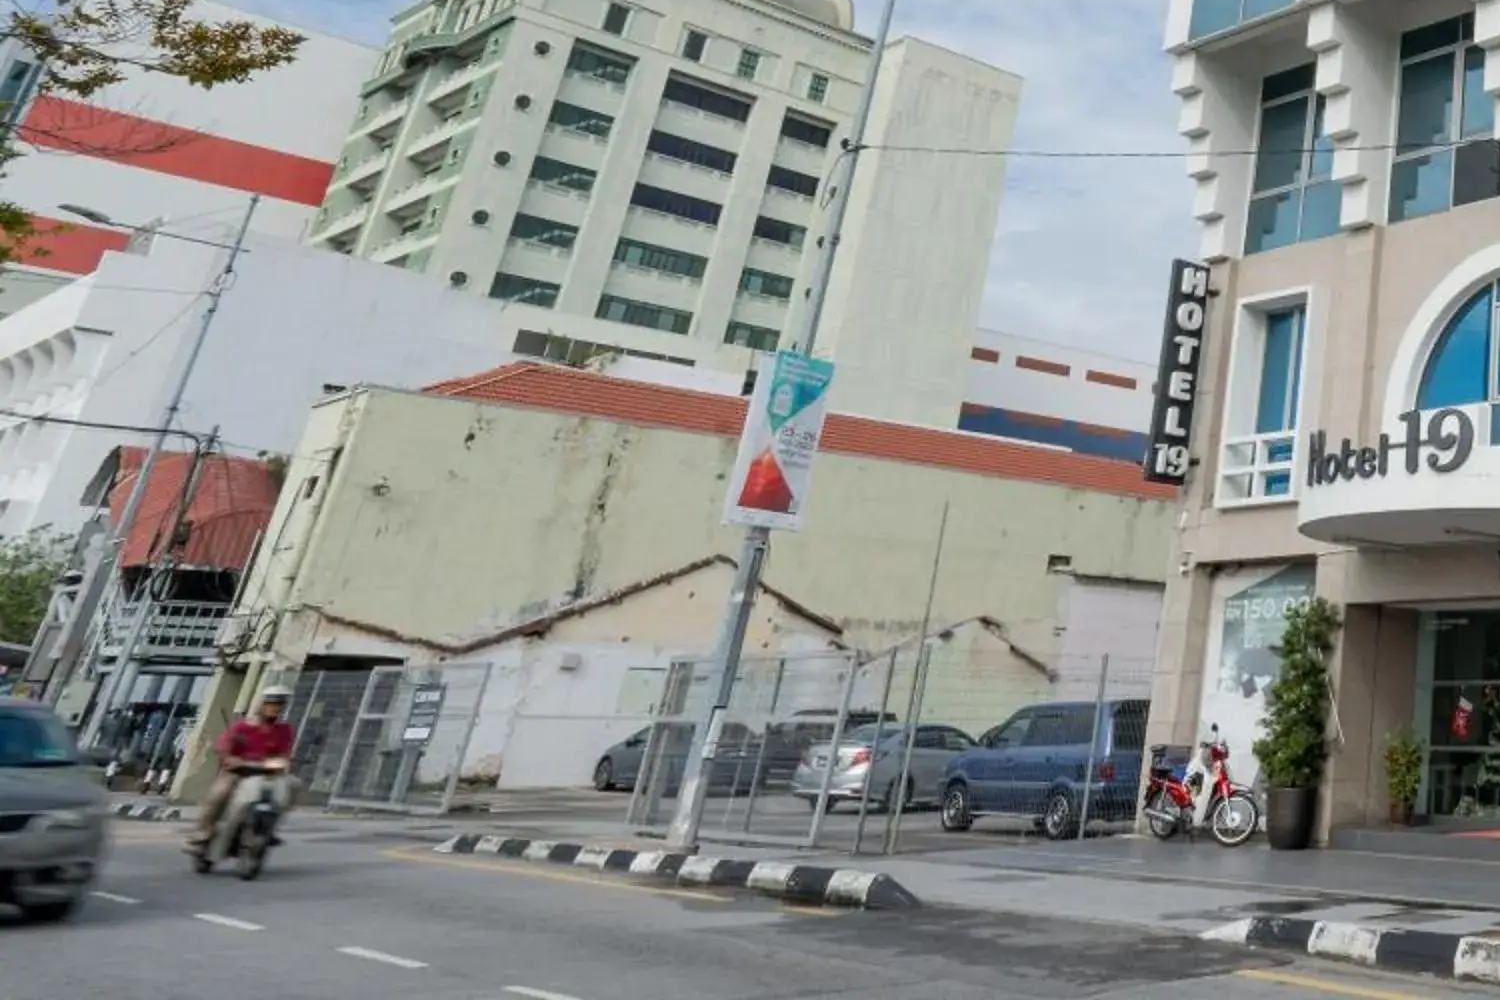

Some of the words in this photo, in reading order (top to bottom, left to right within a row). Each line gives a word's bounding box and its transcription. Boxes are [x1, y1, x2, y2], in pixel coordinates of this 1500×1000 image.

[1164, 267, 1207, 437] HOTEL
[1154, 443, 1190, 477] 19
[1307, 430, 1389, 487] Hotel
[1398, 408, 1475, 475] 19
